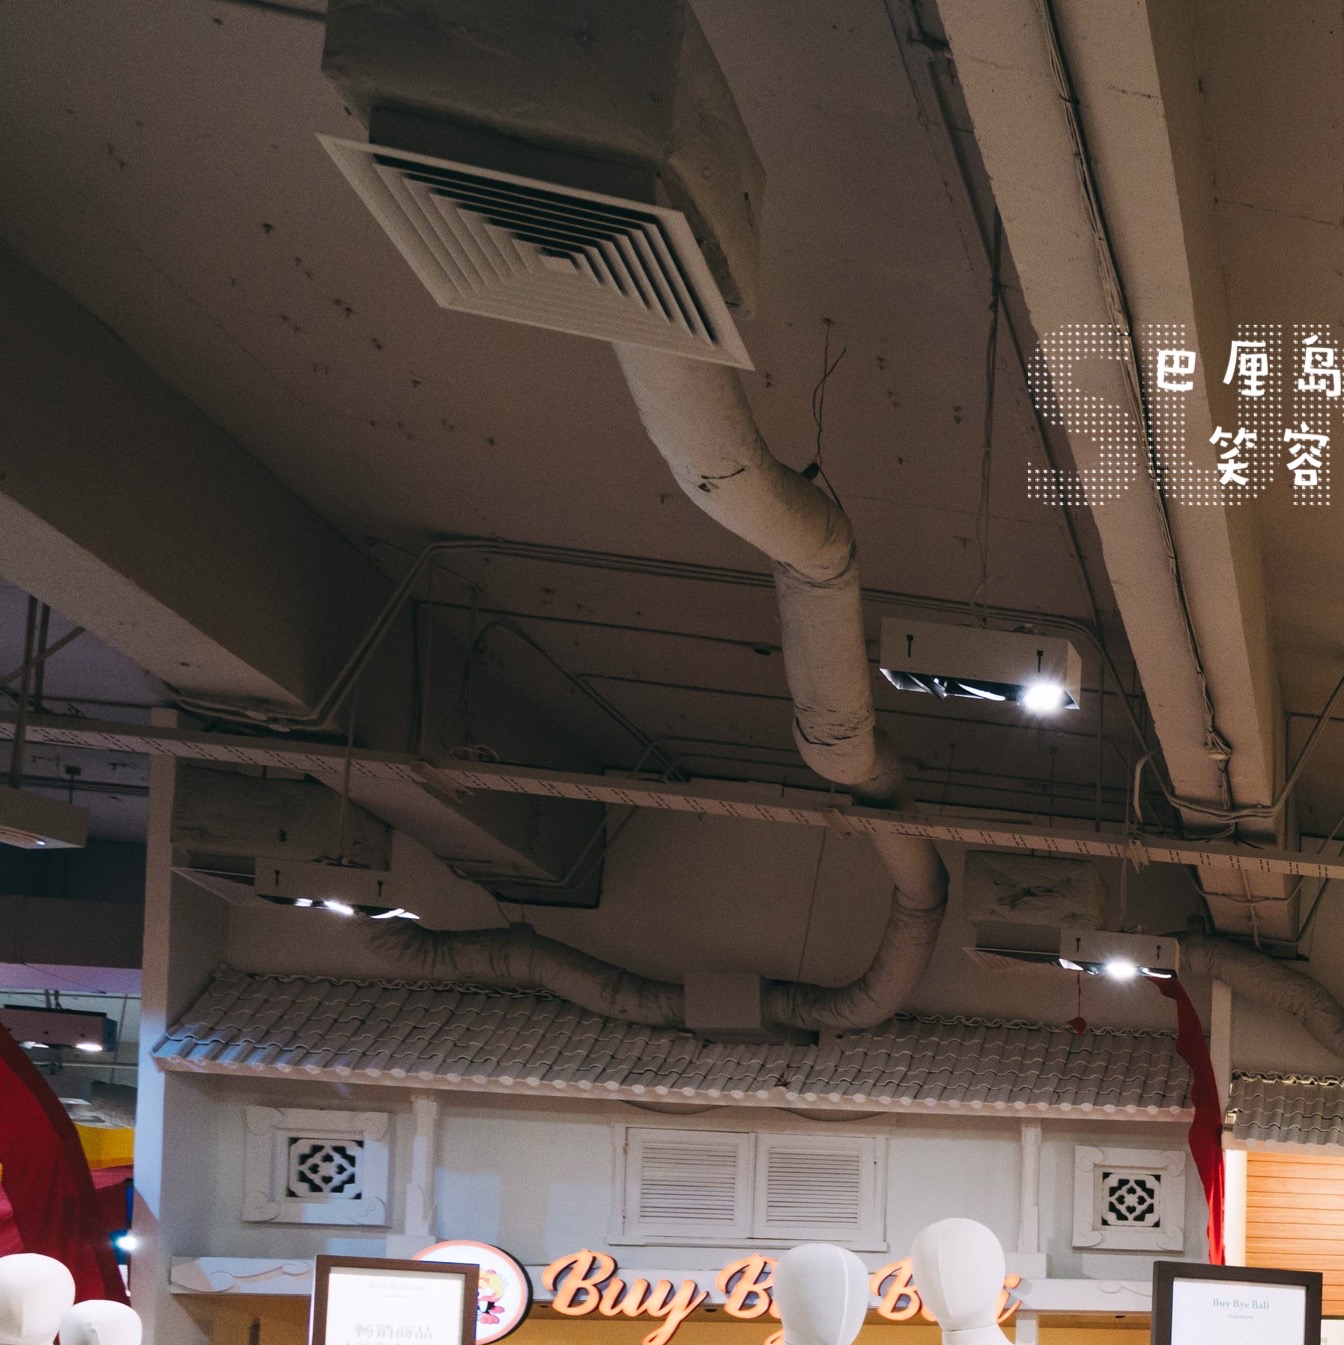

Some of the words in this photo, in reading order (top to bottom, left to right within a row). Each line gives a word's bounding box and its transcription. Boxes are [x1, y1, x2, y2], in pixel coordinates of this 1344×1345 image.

[1213, 1298, 1231, 1309] Buy
[1233, 1299, 1250, 1311] Bye
[1252, 1300, 1270, 1310] Bali
